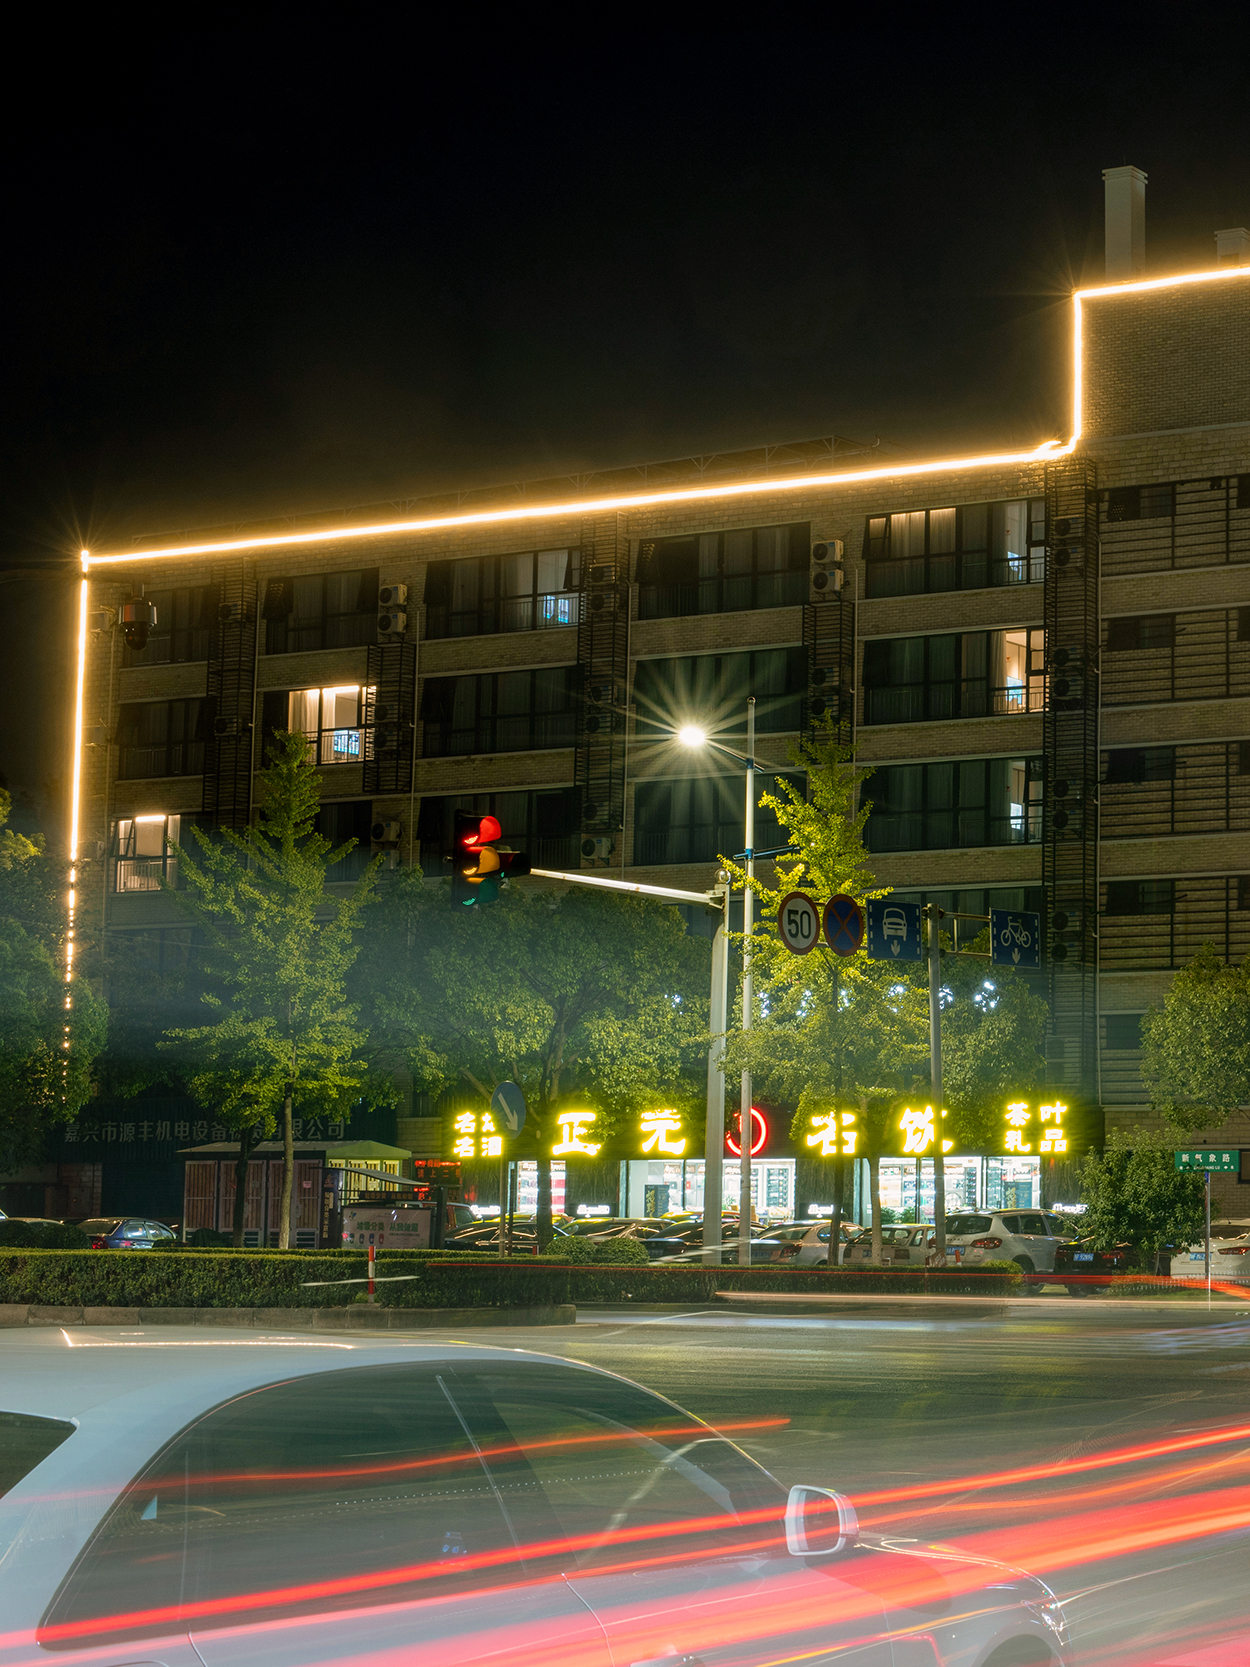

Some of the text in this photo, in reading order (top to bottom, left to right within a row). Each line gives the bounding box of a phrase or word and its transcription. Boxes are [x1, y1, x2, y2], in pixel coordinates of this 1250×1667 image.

[787, 909, 811, 940] 50
[1005, 1101, 1067, 1127] 茶叶
[552, 1109, 687, 1156] 正元
[1005, 1128, 1067, 1153] 礼品
[453, 1135, 503, 1157] 名酒
[1181, 1153, 1230, 1163] 新气象路
